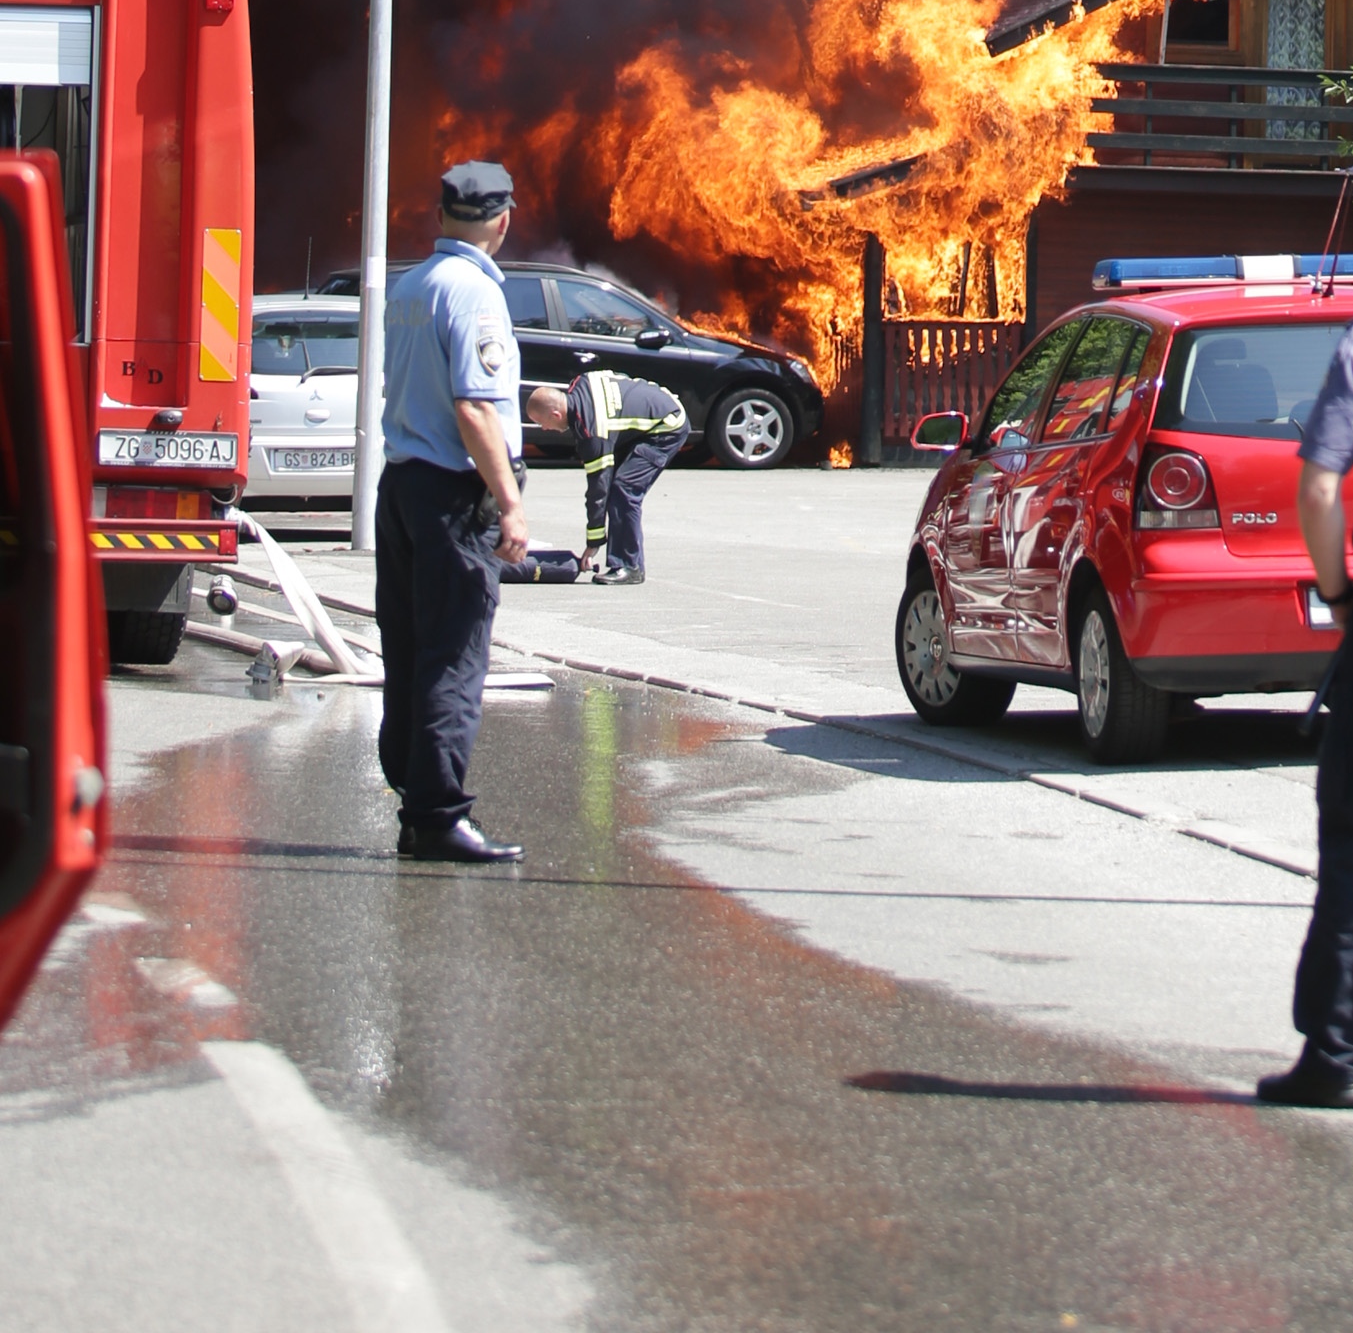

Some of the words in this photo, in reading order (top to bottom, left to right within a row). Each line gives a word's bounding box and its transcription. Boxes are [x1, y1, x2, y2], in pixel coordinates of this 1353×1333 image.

[122, 361, 135, 376] B
[148, 369, 163, 384] D
[115, 436, 139, 459] ZG
[155, 437, 234, 462] 5096-AJ
[284, 452, 301, 468] GS
[1231, 511, 1278, 525] POLO
